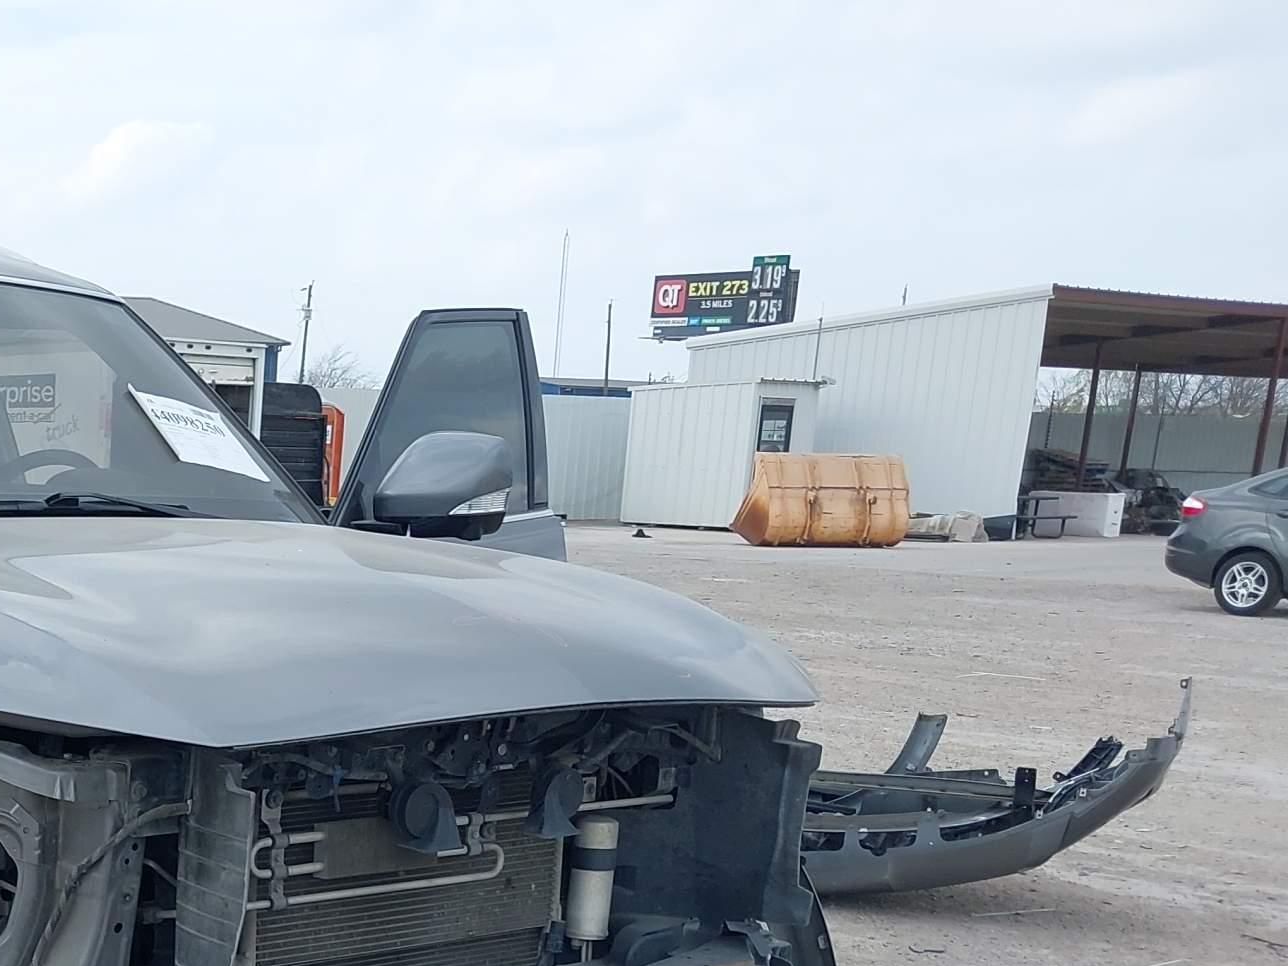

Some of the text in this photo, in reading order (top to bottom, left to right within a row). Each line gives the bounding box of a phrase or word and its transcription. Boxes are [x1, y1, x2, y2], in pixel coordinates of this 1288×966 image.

[658, 284, 682, 307] QT
[688, 281, 721, 297] EXIT
[722, 279, 749, 295] 273
[711, 299, 734, 308] MILES
[46, 414, 80, 442] truck
